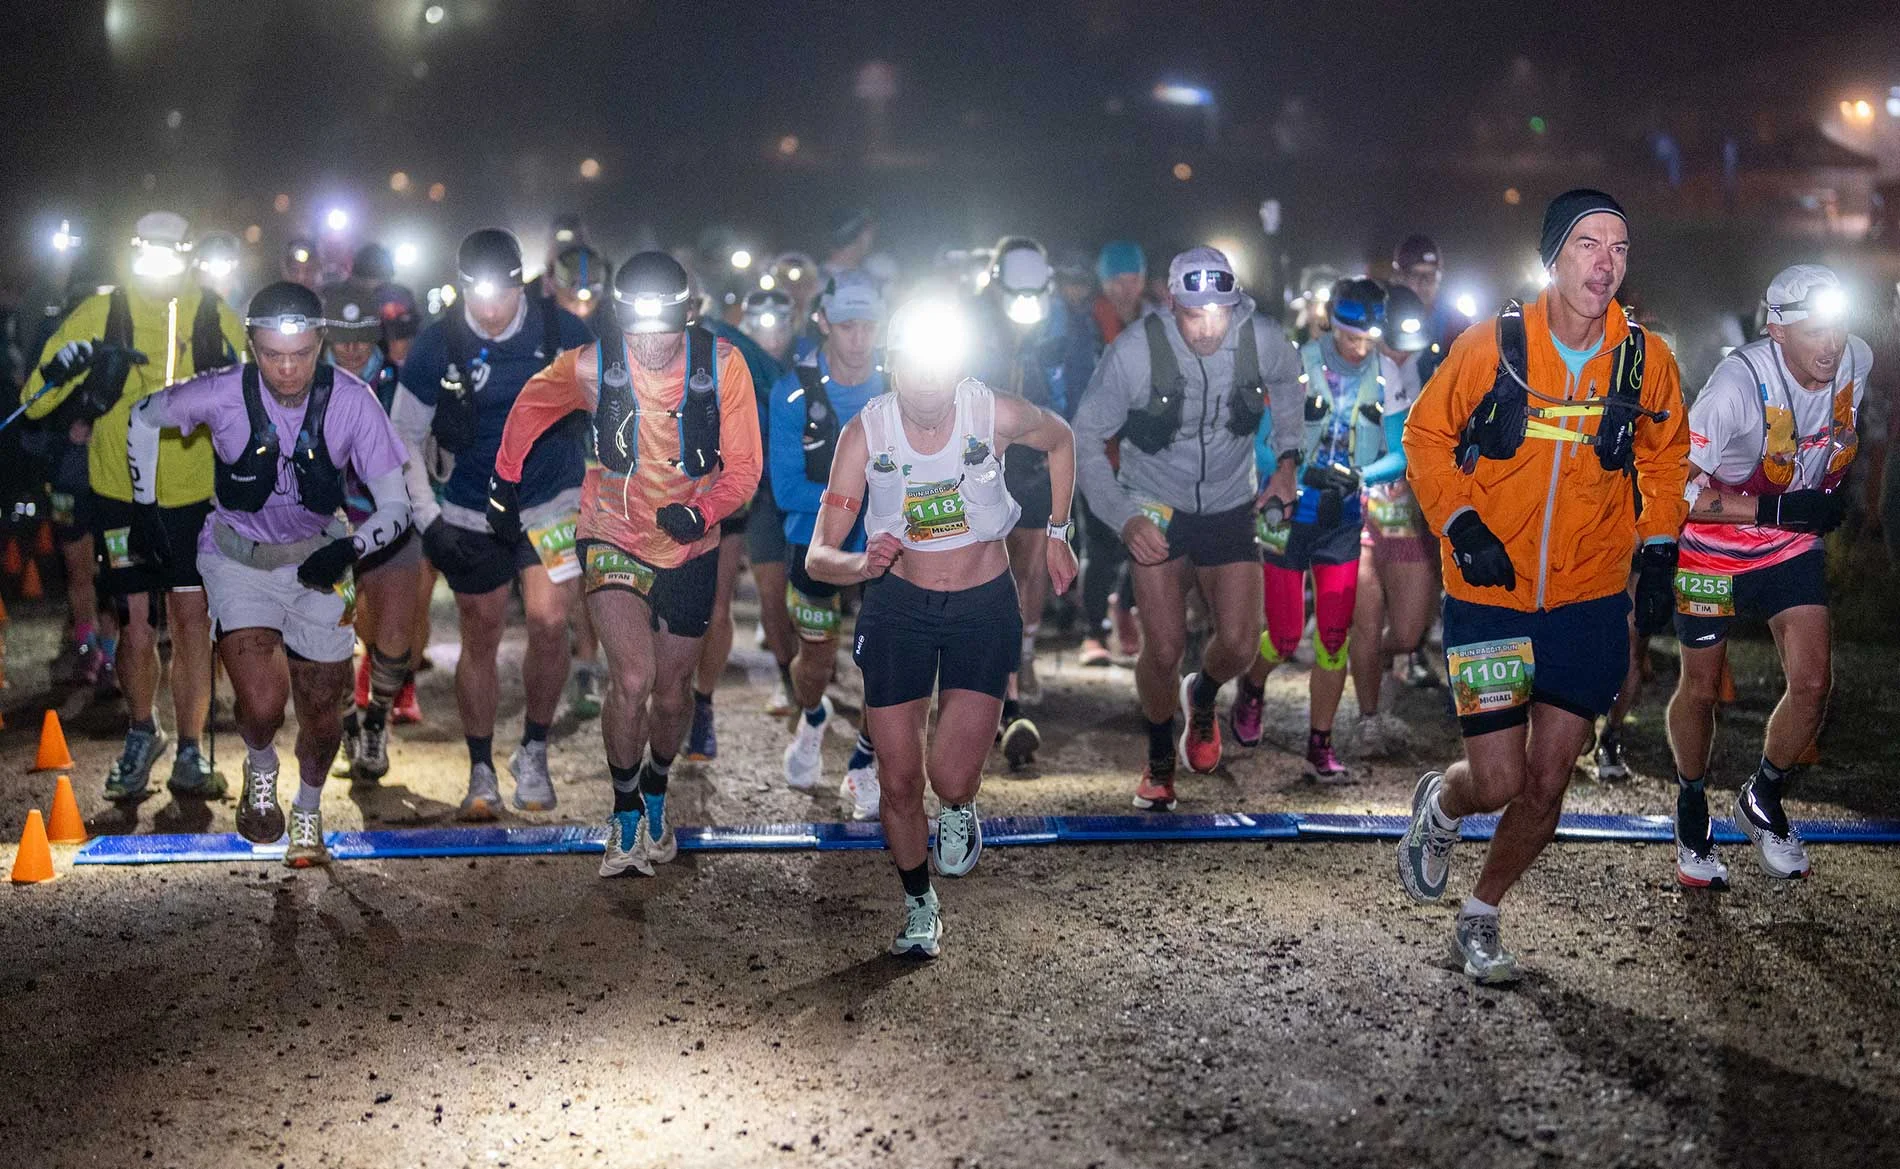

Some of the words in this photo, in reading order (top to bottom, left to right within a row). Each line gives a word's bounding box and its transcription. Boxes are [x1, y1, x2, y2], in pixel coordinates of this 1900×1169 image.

[931, 522, 963, 534] MEGAN
[608, 572, 631, 581] RYAN
[1677, 576, 1728, 595] 1255
[1694, 604, 1712, 613] TIM
[795, 606, 834, 624] 1081
[1502, 643, 1518, 651] RUN
[1462, 660, 1521, 683] 1107
[1479, 693, 1512, 704] MICHAEL
